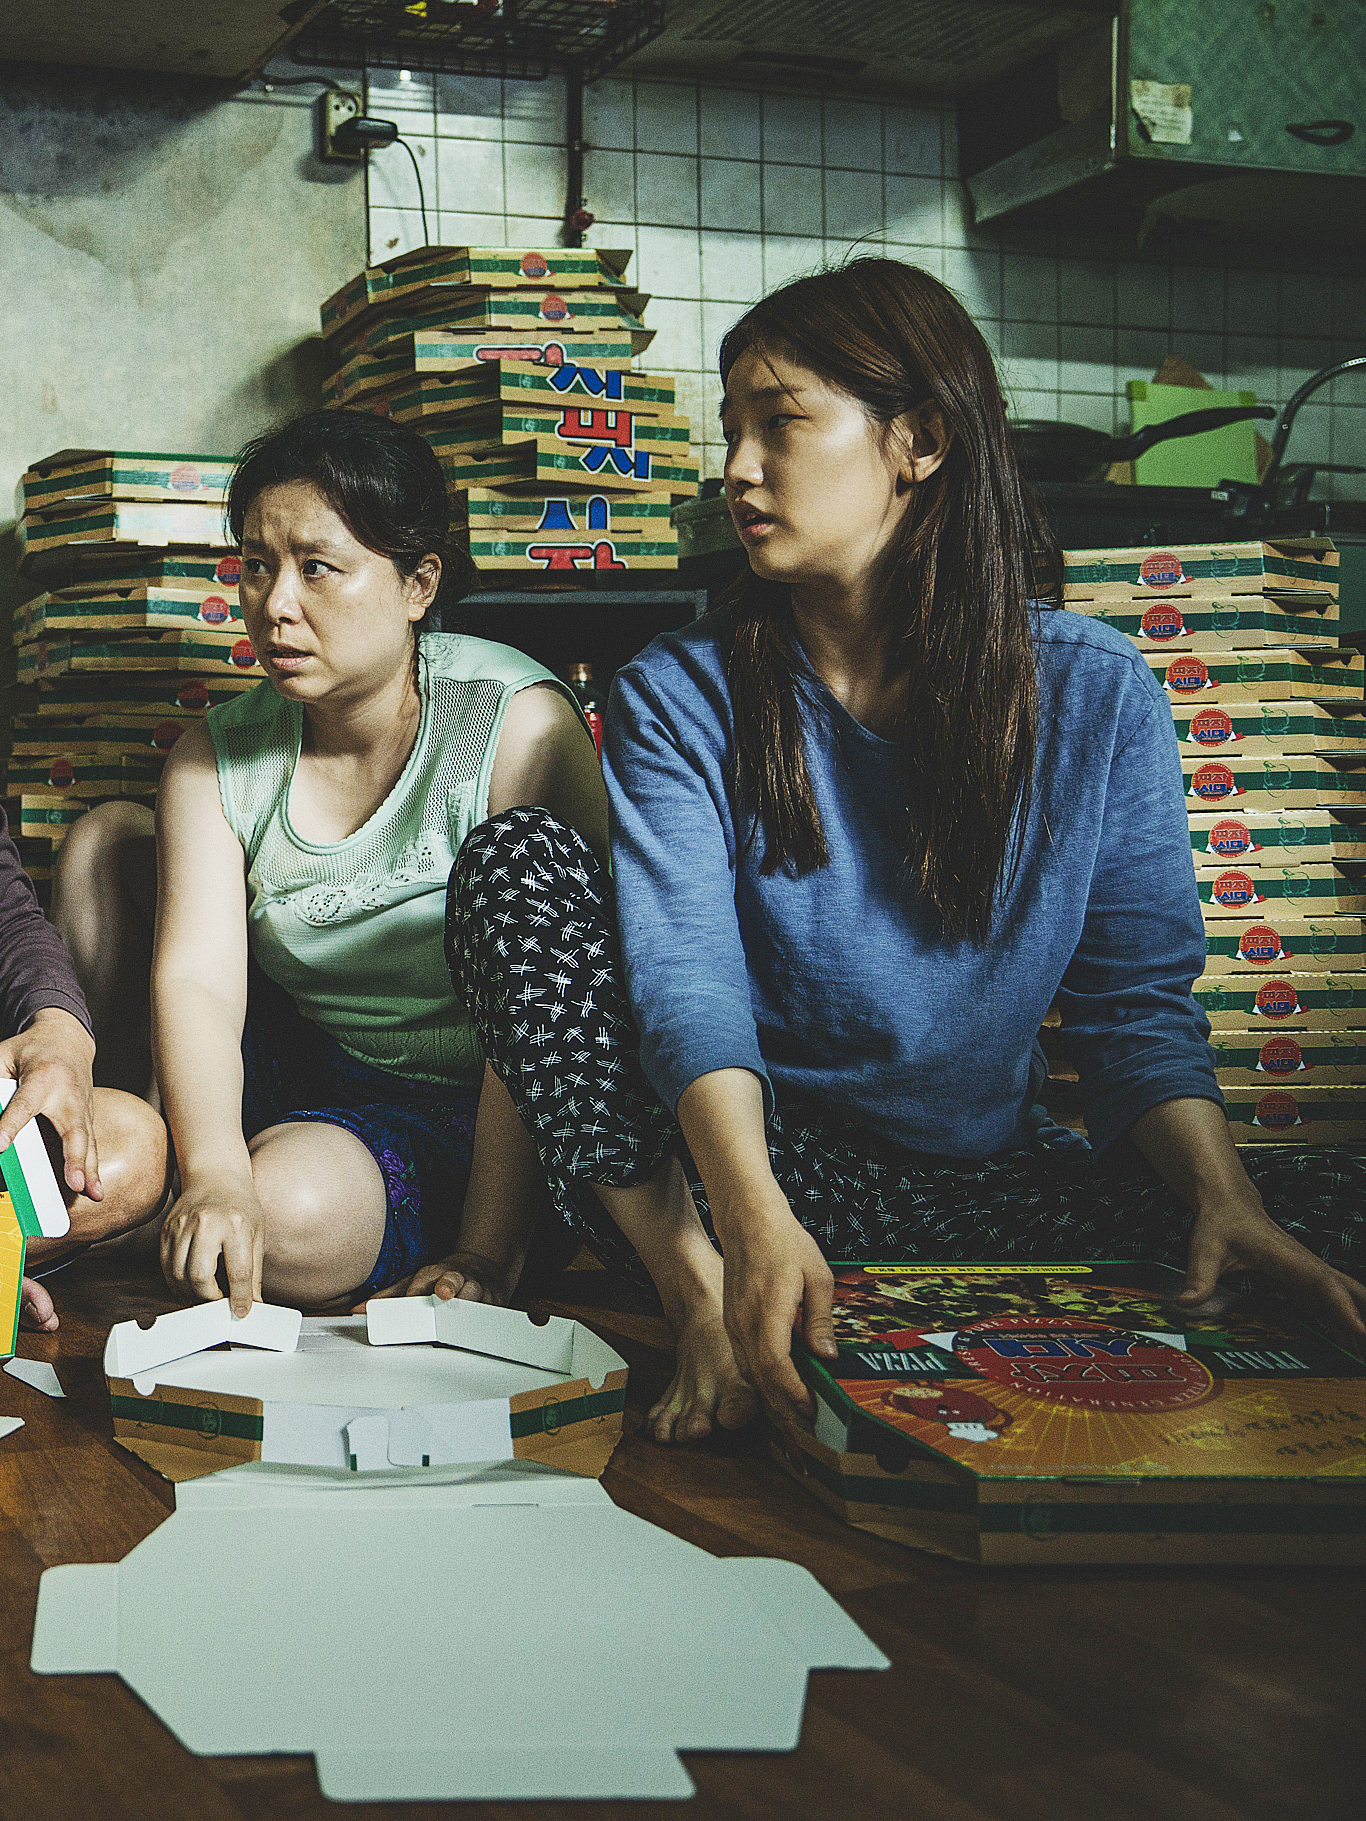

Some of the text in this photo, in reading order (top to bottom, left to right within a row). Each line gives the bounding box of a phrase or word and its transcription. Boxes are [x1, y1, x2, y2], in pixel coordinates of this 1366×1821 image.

[1174, 676, 1201, 685] 시대
[1198, 728, 1225, 737] 시대
[1200, 783, 1227, 792] 시대
[1217, 840, 1243, 849] 시대
[1221, 890, 1247, 900] 시대
[1247, 946, 1274, 955] 시대
[982, 1338, 1138, 1358] 시대
[855, 1352, 949, 1371] PIZZA
[1212, 1351, 1311, 1370] ITALY
[1010, 1362, 1187, 1383] 피자
